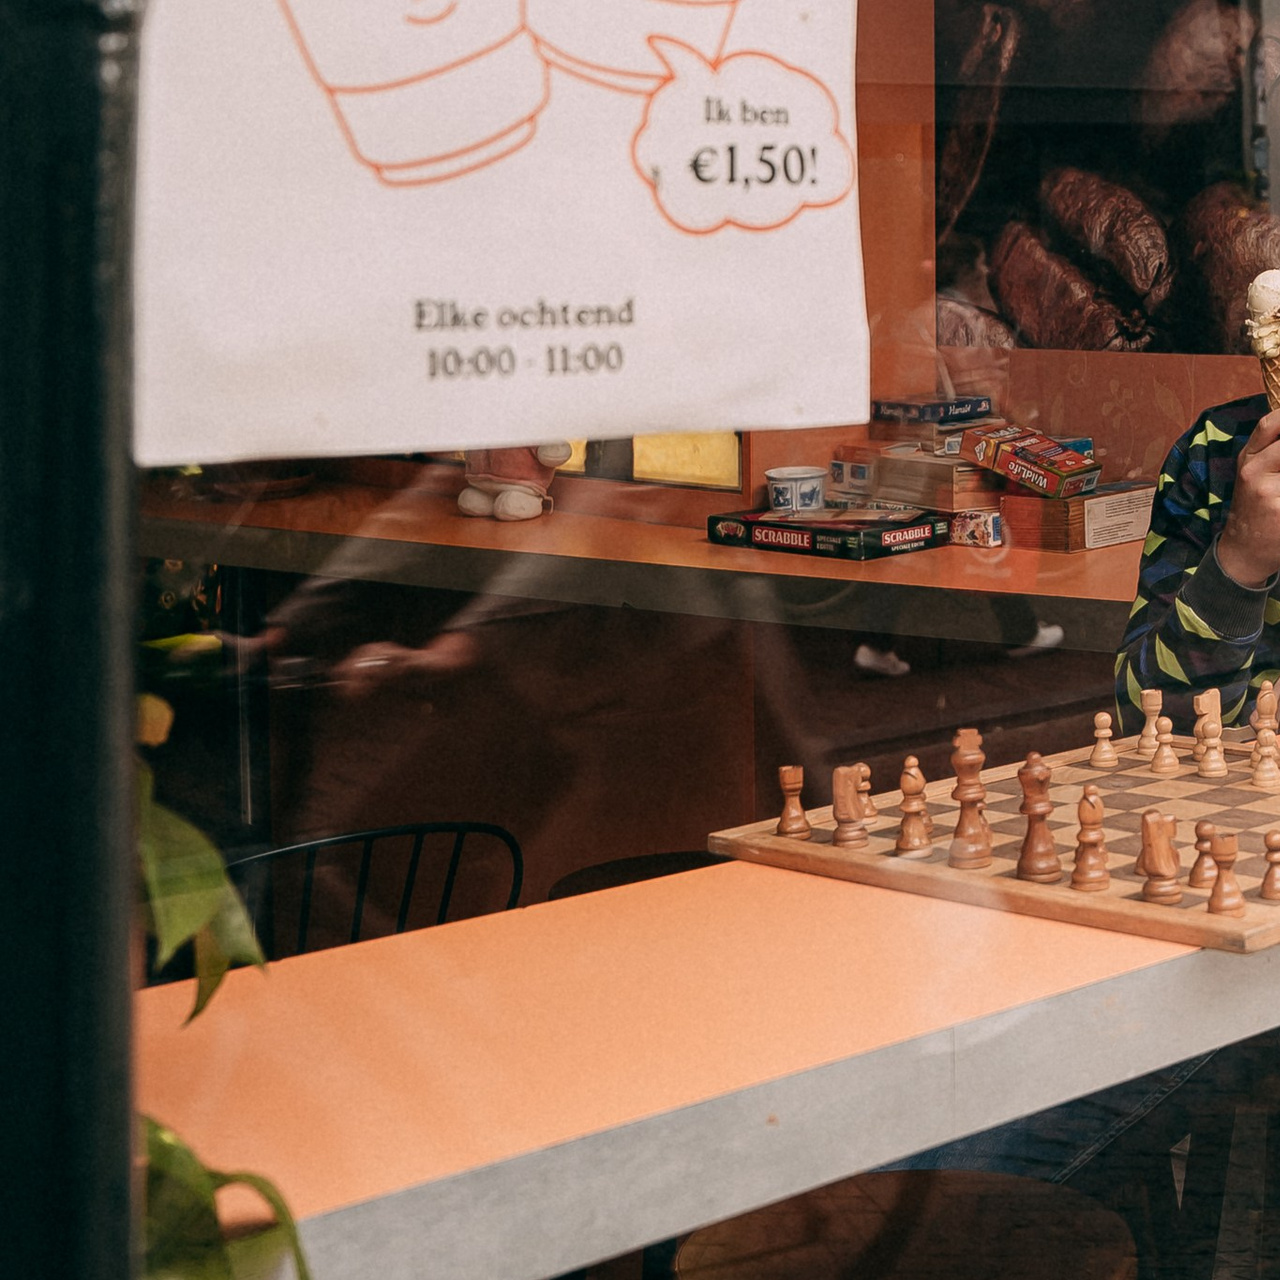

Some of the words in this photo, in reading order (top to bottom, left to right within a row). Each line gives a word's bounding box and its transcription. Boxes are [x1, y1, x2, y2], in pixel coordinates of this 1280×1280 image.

[704, 96, 732, 125] Ik
[740, 96, 790, 126] ben
[688, 143, 818, 190] €1,50!
[414, 298, 489, 332] Elke
[496, 298, 635, 330] ochtend
[427, 346, 517, 381] 10:00
[545, 342, 624, 376] 11:00
[1007, 460, 1048, 489] WildLife
[754, 528, 811, 548] SCRABBLE
[883, 526, 931, 544] SCRABBLE
